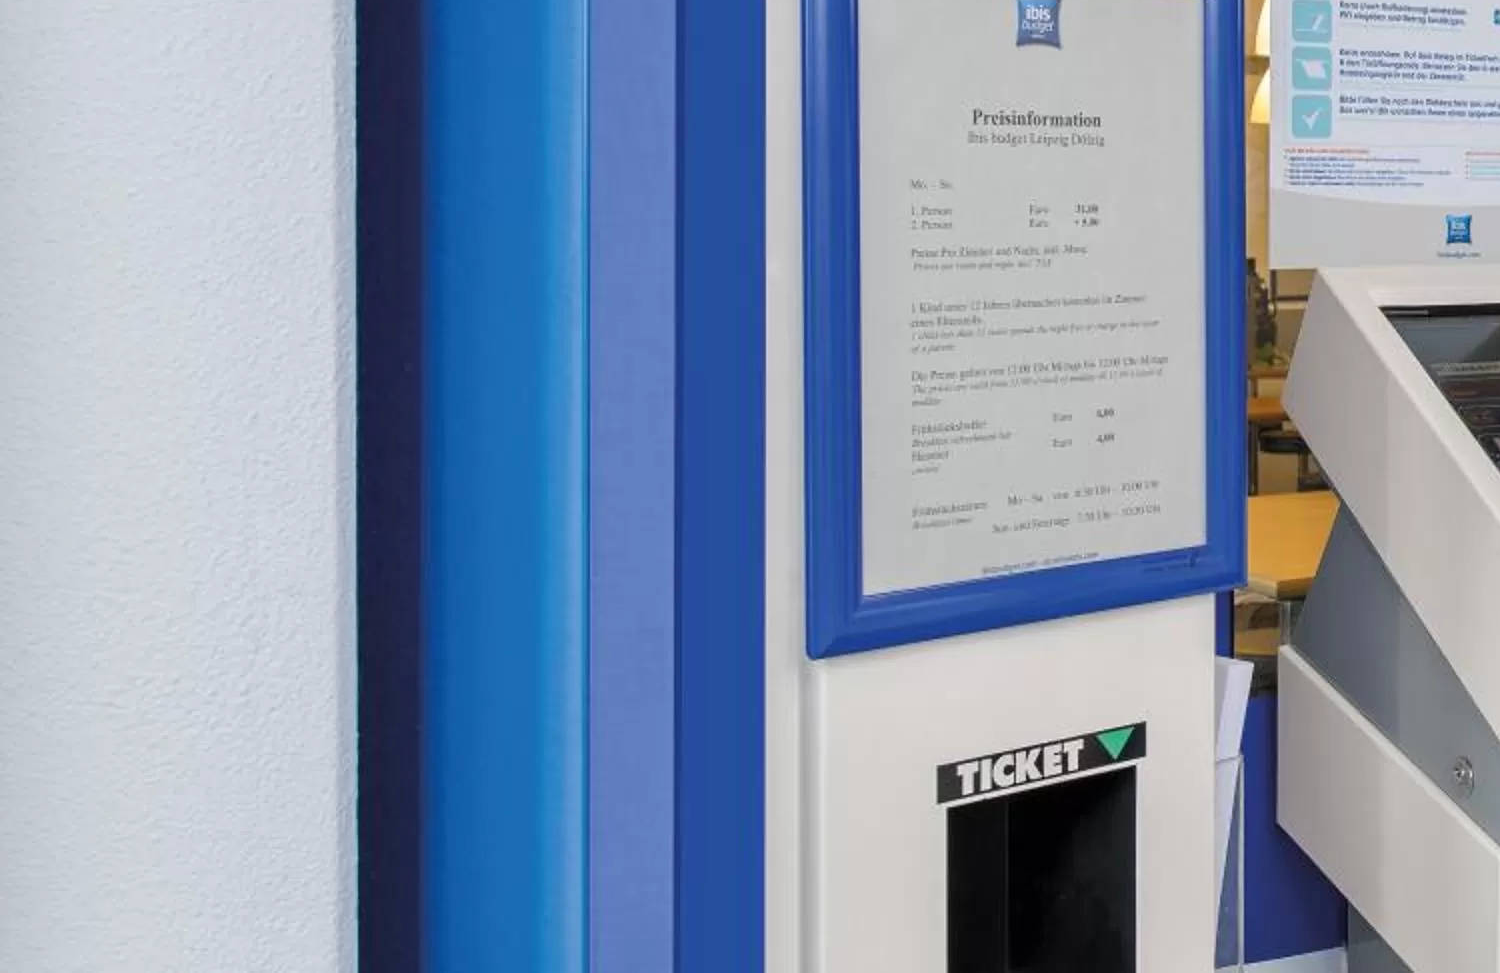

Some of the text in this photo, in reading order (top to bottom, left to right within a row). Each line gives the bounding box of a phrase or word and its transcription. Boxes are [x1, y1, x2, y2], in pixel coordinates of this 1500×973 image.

[1025, 4, 1051, 21] ibis
[972, 108, 1101, 128] Preisinformation
[991, 132, 1027, 147] budget
[957, 738, 1085, 796] TICKET
